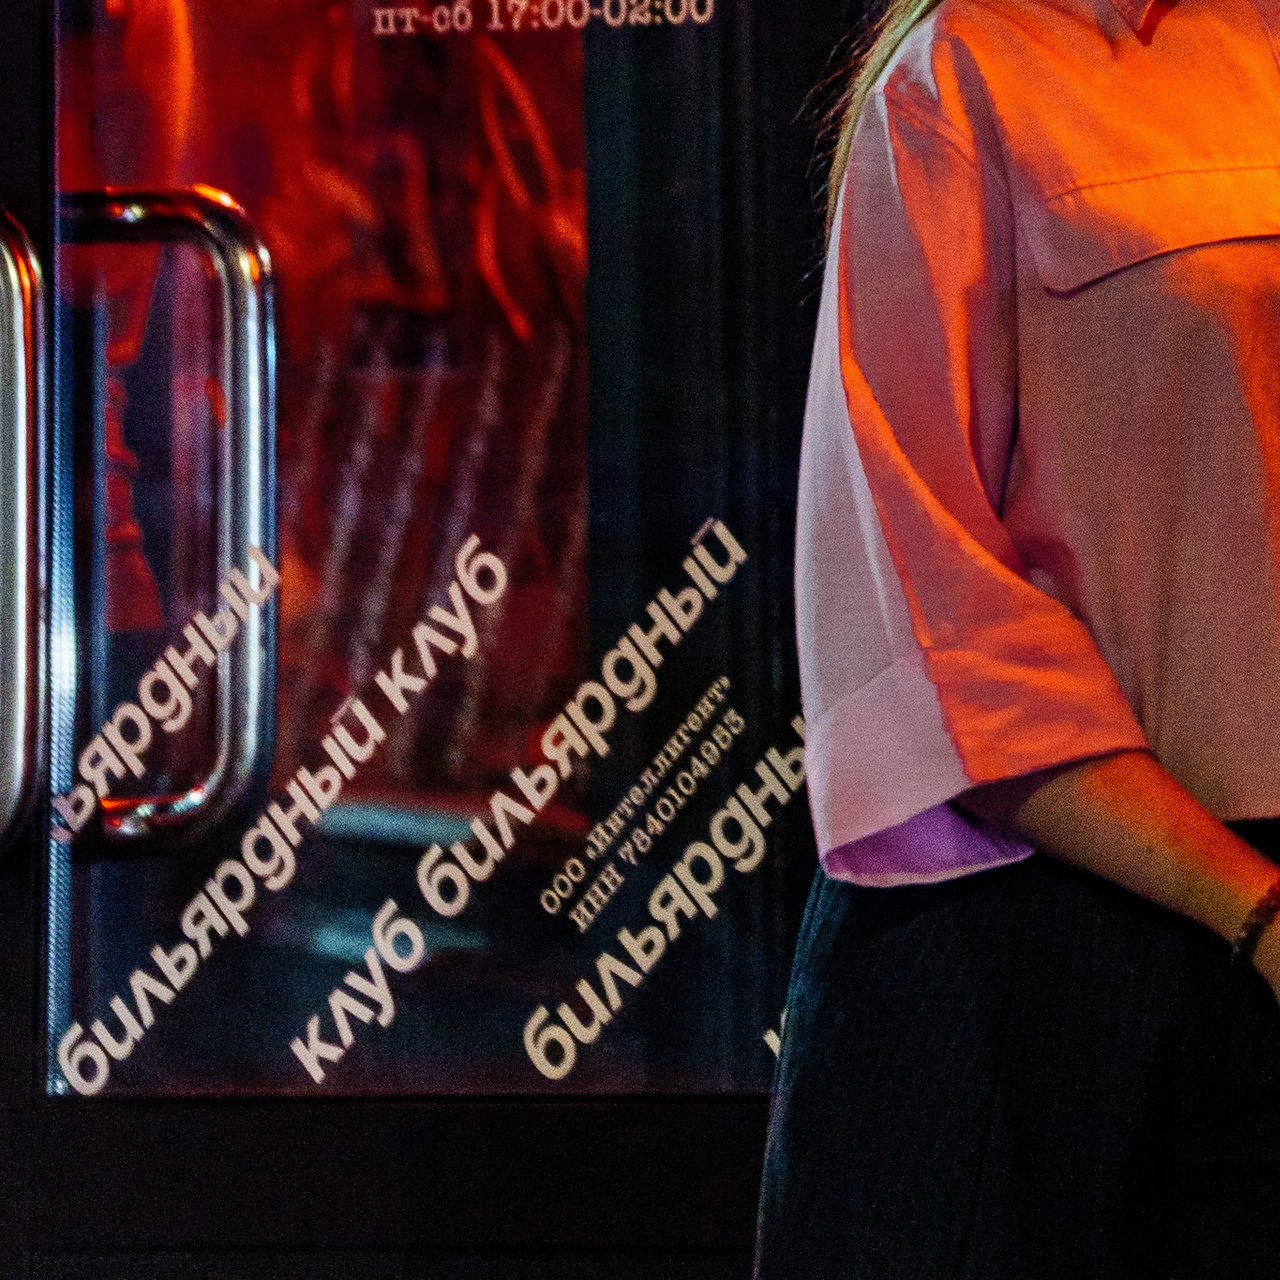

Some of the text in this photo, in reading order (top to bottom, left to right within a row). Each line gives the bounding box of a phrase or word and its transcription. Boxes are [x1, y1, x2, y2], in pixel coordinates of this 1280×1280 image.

[50, 544, 280, 843] ьярдный
[57, 534, 508, 1097] бильярдный клуб
[289, 517, 749, 1084] клуб бильярдный
[522, 713, 806, 1081] бильярдны
[540, 856, 587, 915] ООО
[568, 861, 625, 934] ИНН
